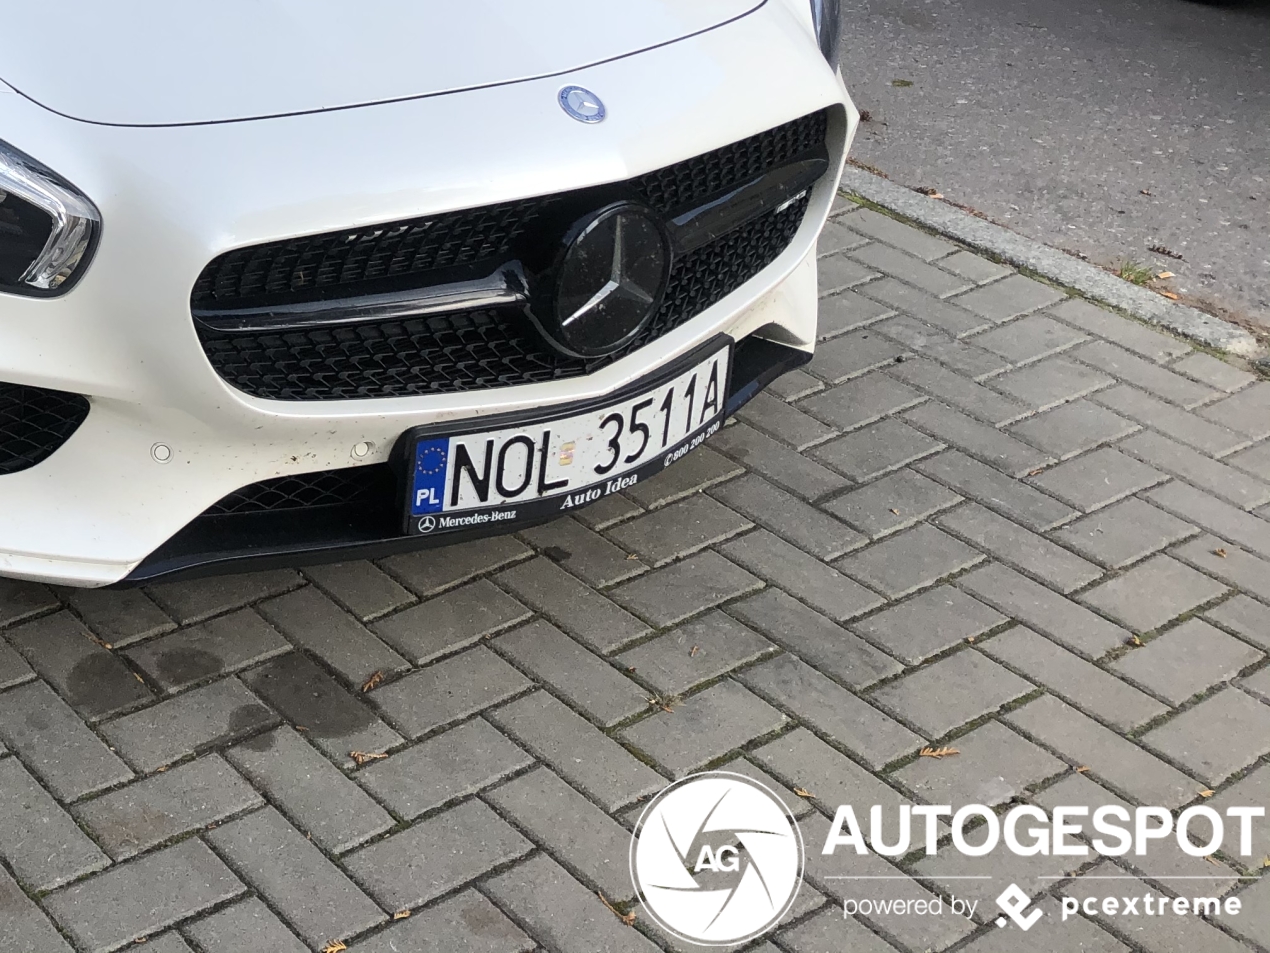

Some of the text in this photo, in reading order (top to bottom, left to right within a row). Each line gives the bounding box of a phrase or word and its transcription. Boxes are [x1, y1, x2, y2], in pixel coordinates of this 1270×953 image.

[415, 359, 719, 507] PL NOL 3511A
[438, 510, 517, 529] Mercedes-Benz
[560, 486, 601, 510] Auto
[604, 473, 638, 496] Idea
[690, 432, 705, 450] 200
